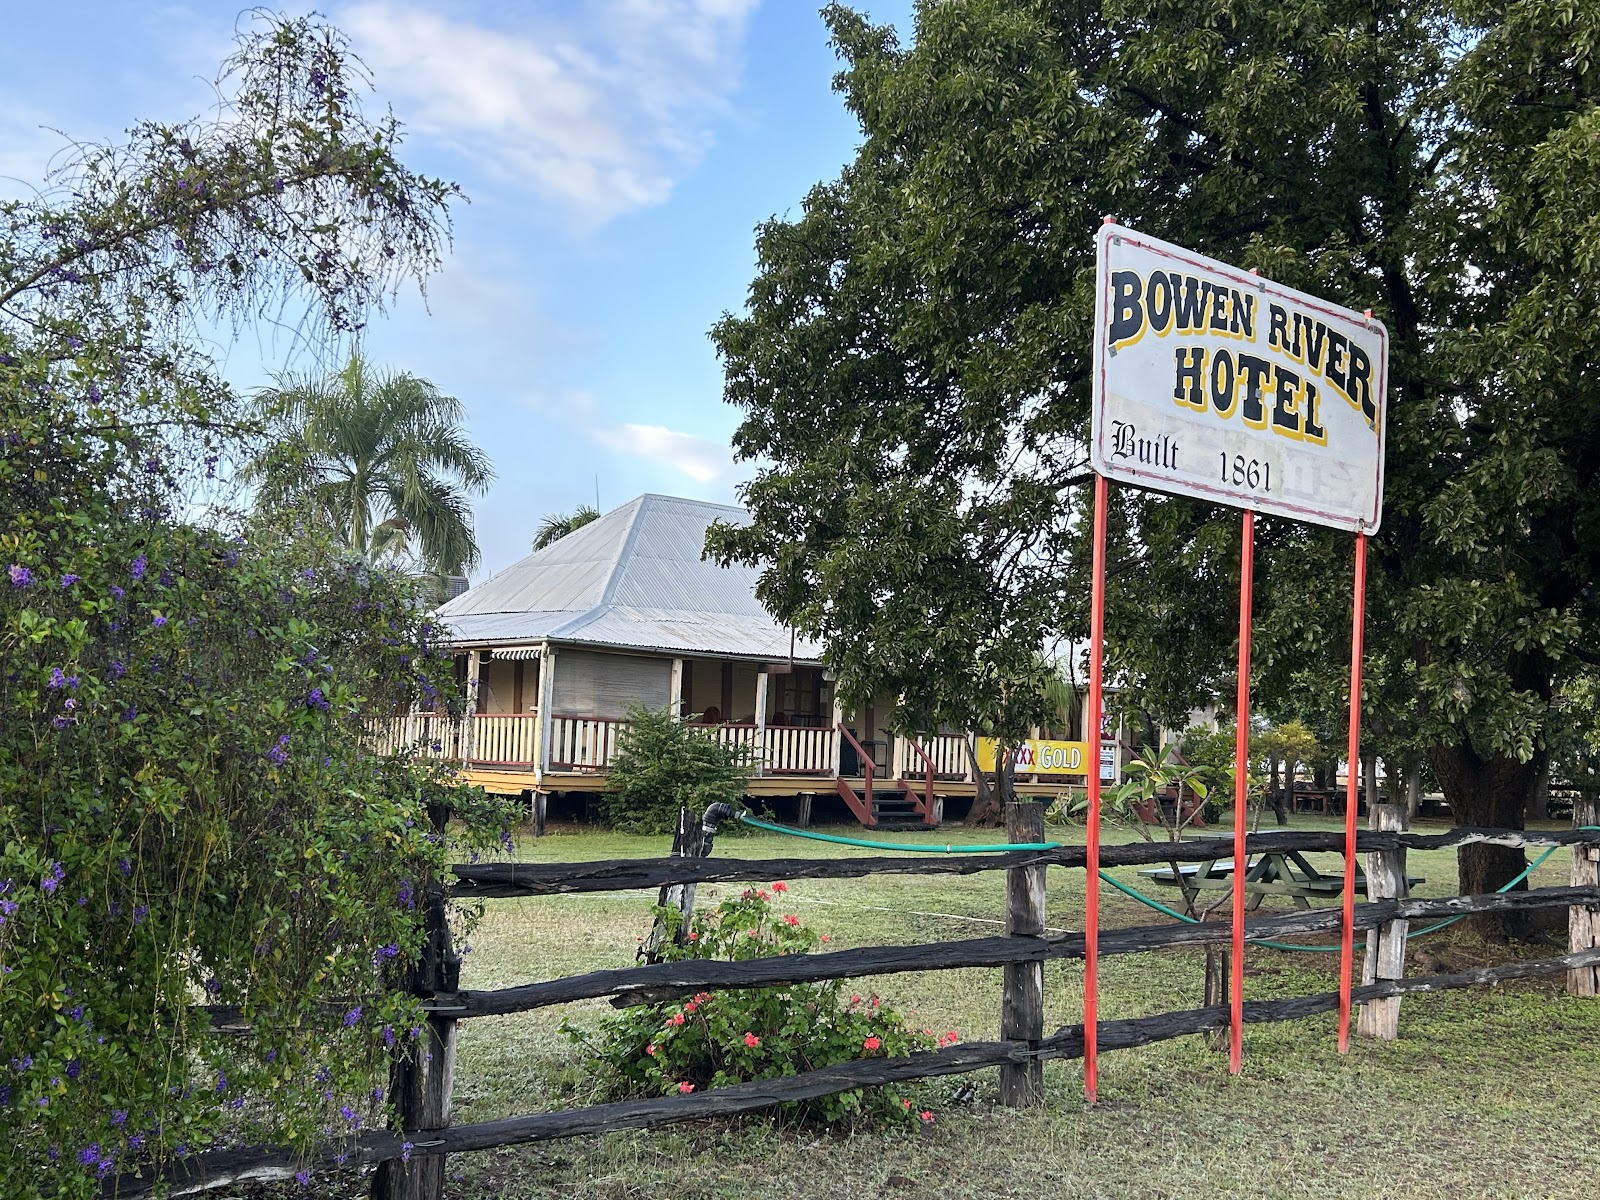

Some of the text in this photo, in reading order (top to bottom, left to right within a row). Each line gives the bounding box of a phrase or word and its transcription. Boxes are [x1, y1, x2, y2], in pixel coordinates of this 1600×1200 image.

[1108, 268, 1377, 430] BOWEN RIVER
[1173, 347, 1326, 445] HOTEL
[1111, 420, 1272, 493] Built 1861
[1002, 747, 1036, 766] XXX
[1041, 745, 1081, 769] GOLD
